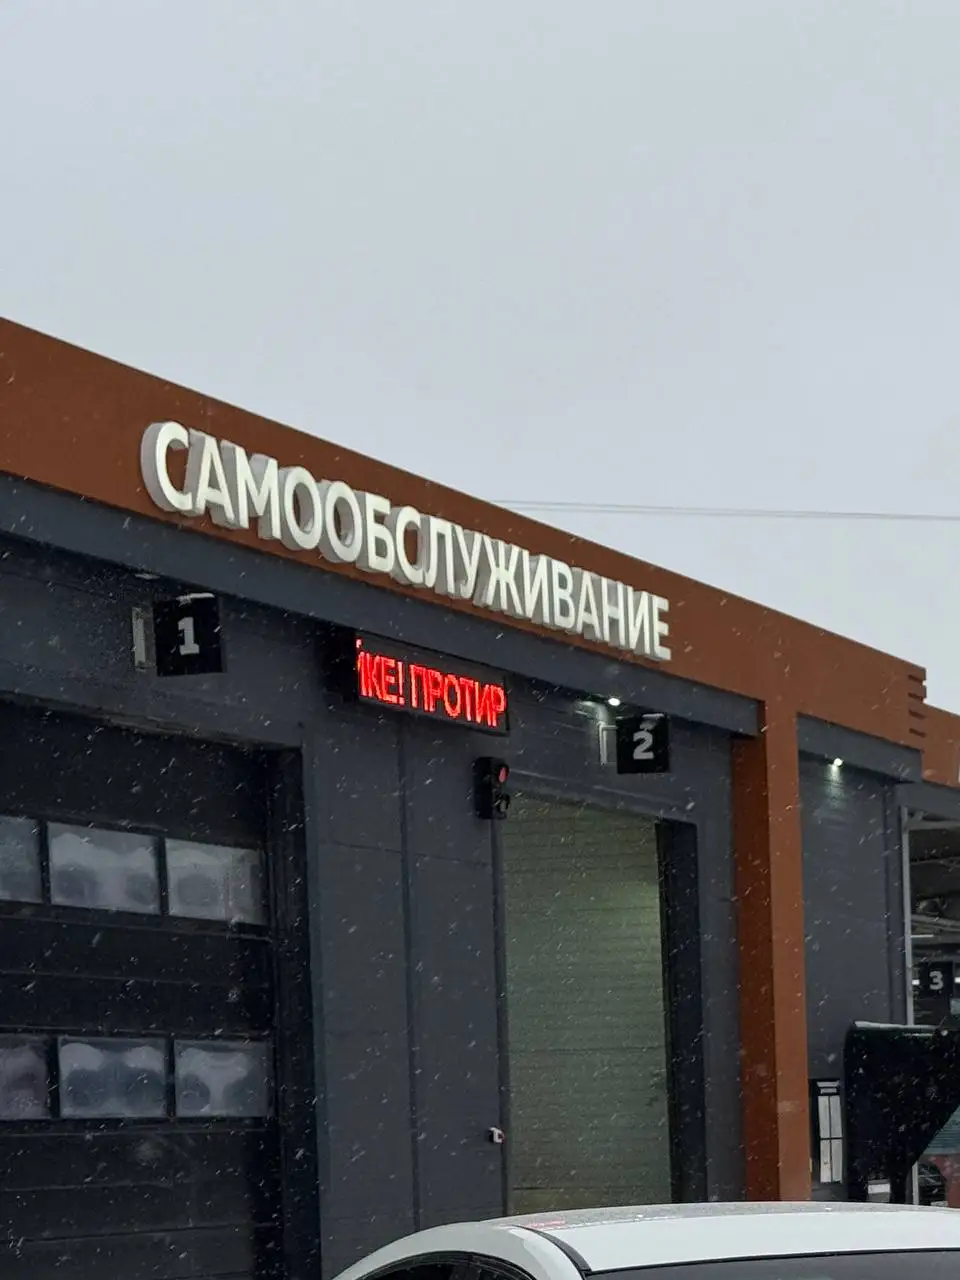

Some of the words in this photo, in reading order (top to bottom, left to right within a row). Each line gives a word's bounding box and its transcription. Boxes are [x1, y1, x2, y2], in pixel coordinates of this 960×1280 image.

[140, 420, 672, 662] САМООБСЛУЖИВАНИЕ
[178, 616, 200, 656] 1
[410, 663, 507, 728] ПРОТИР
[633, 730, 654, 760] 2
[929, 970, 944, 990] 3
